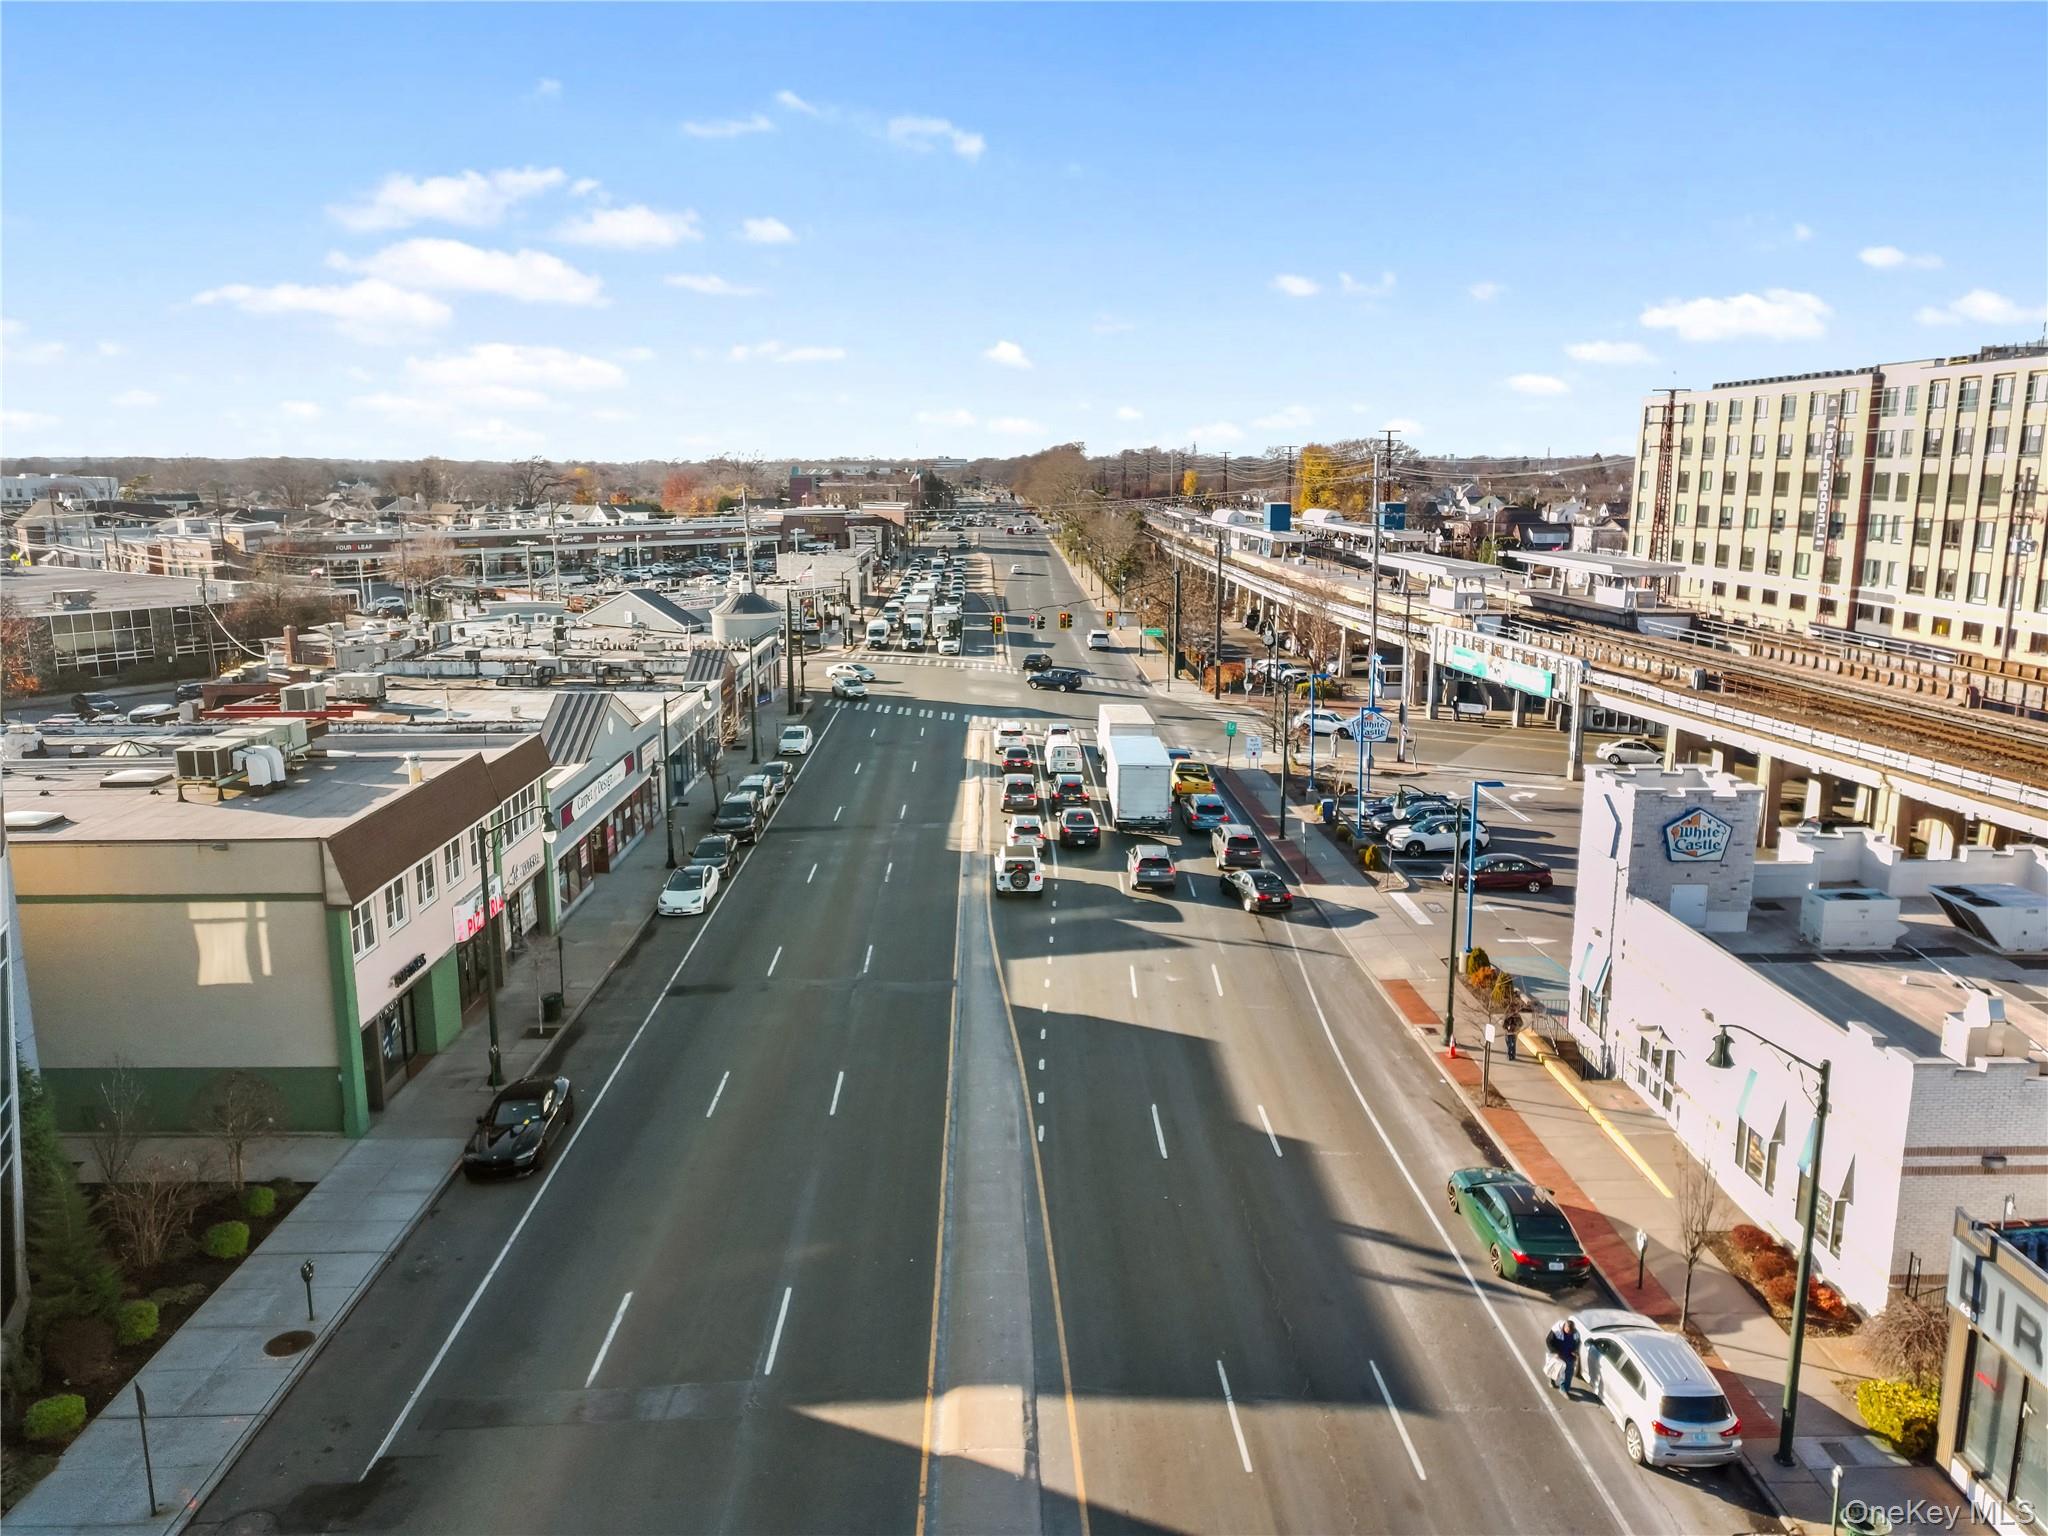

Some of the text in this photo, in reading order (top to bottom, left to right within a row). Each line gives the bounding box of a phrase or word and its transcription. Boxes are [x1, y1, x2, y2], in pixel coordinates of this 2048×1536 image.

[577, 788, 593, 811] Carpet
[597, 774, 614, 795] Design
[1680, 825, 1721, 840] White
[1675, 839, 1721, 851] Castle
